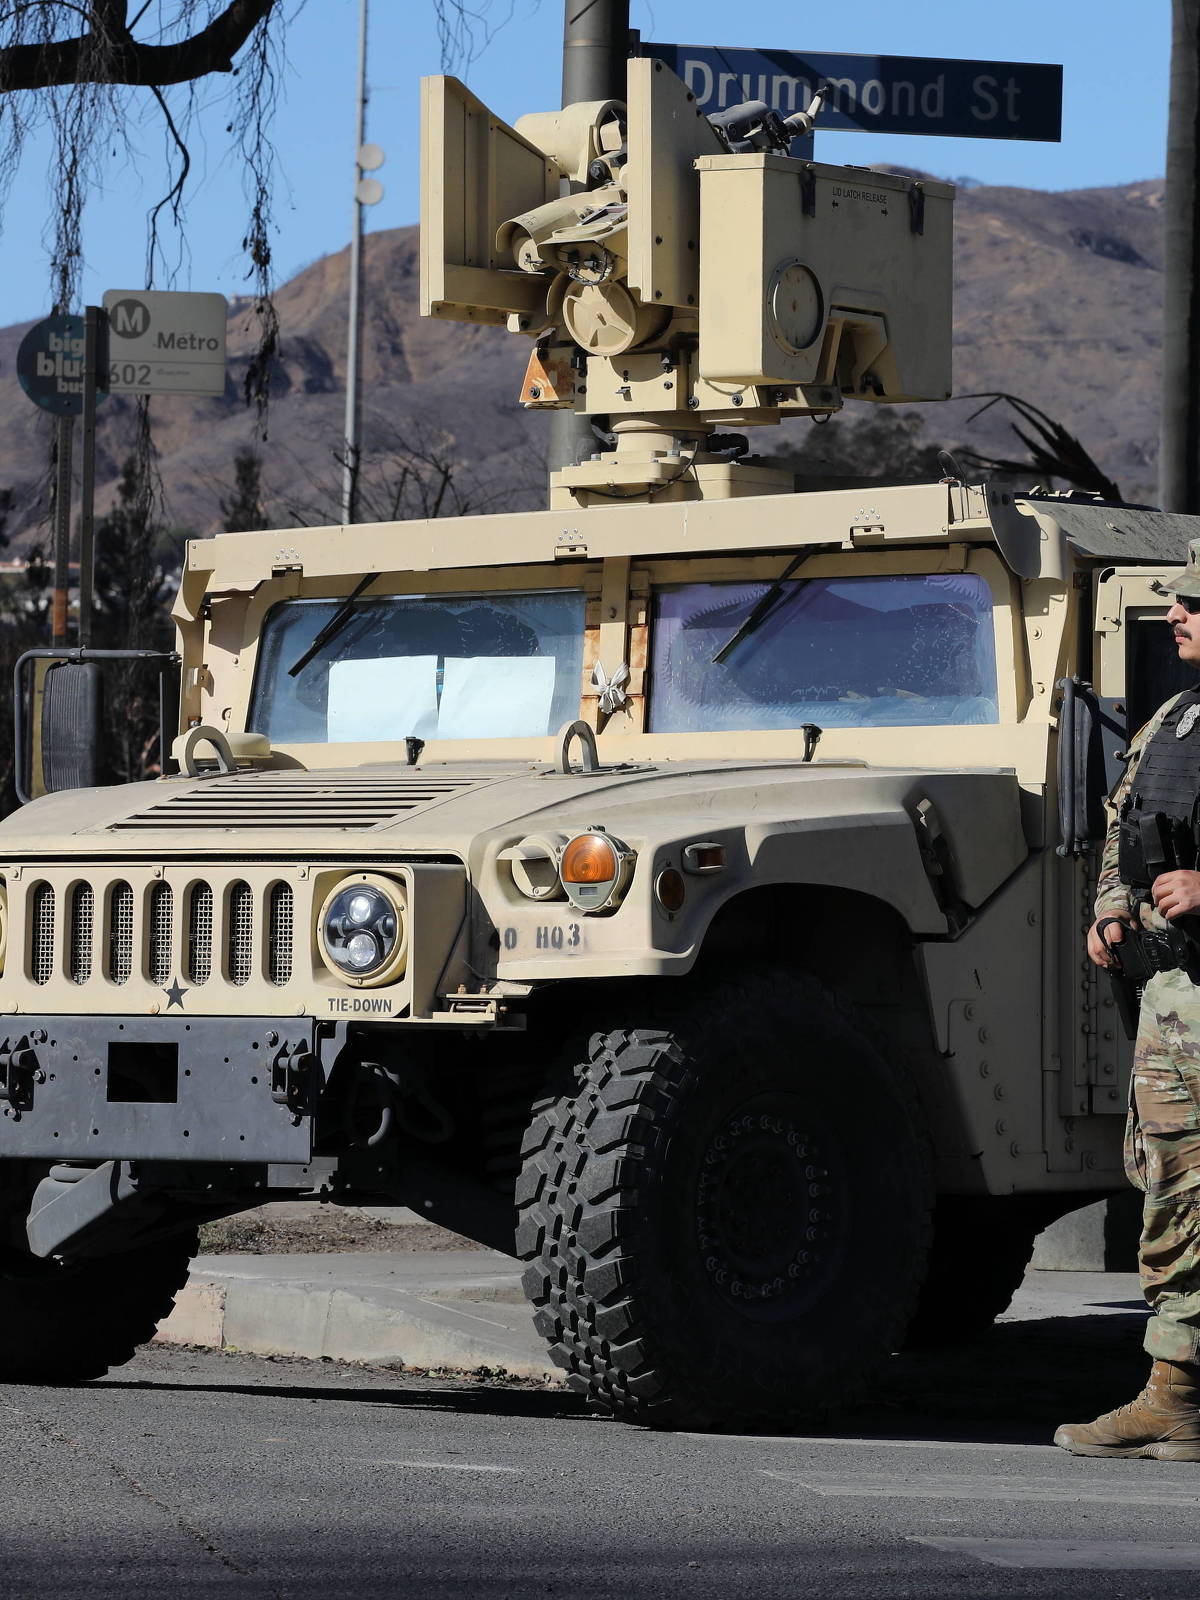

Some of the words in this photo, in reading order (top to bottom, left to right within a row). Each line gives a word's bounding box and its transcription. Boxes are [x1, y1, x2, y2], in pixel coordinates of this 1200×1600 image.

[684, 59, 944, 119] Drummond
[970, 74, 1022, 122] St
[832, 186, 842, 197] LID
[843, 188, 860, 200] LATCH
[862, 191, 887, 204] RELEASE
[116, 306, 143, 333] M
[49, 332, 86, 358] big
[157, 332, 219, 351] Metro
[109, 364, 151, 385] 602
[536, 923, 580, 949] HQ3
[327, 997, 392, 1013] TIE-DOWN
